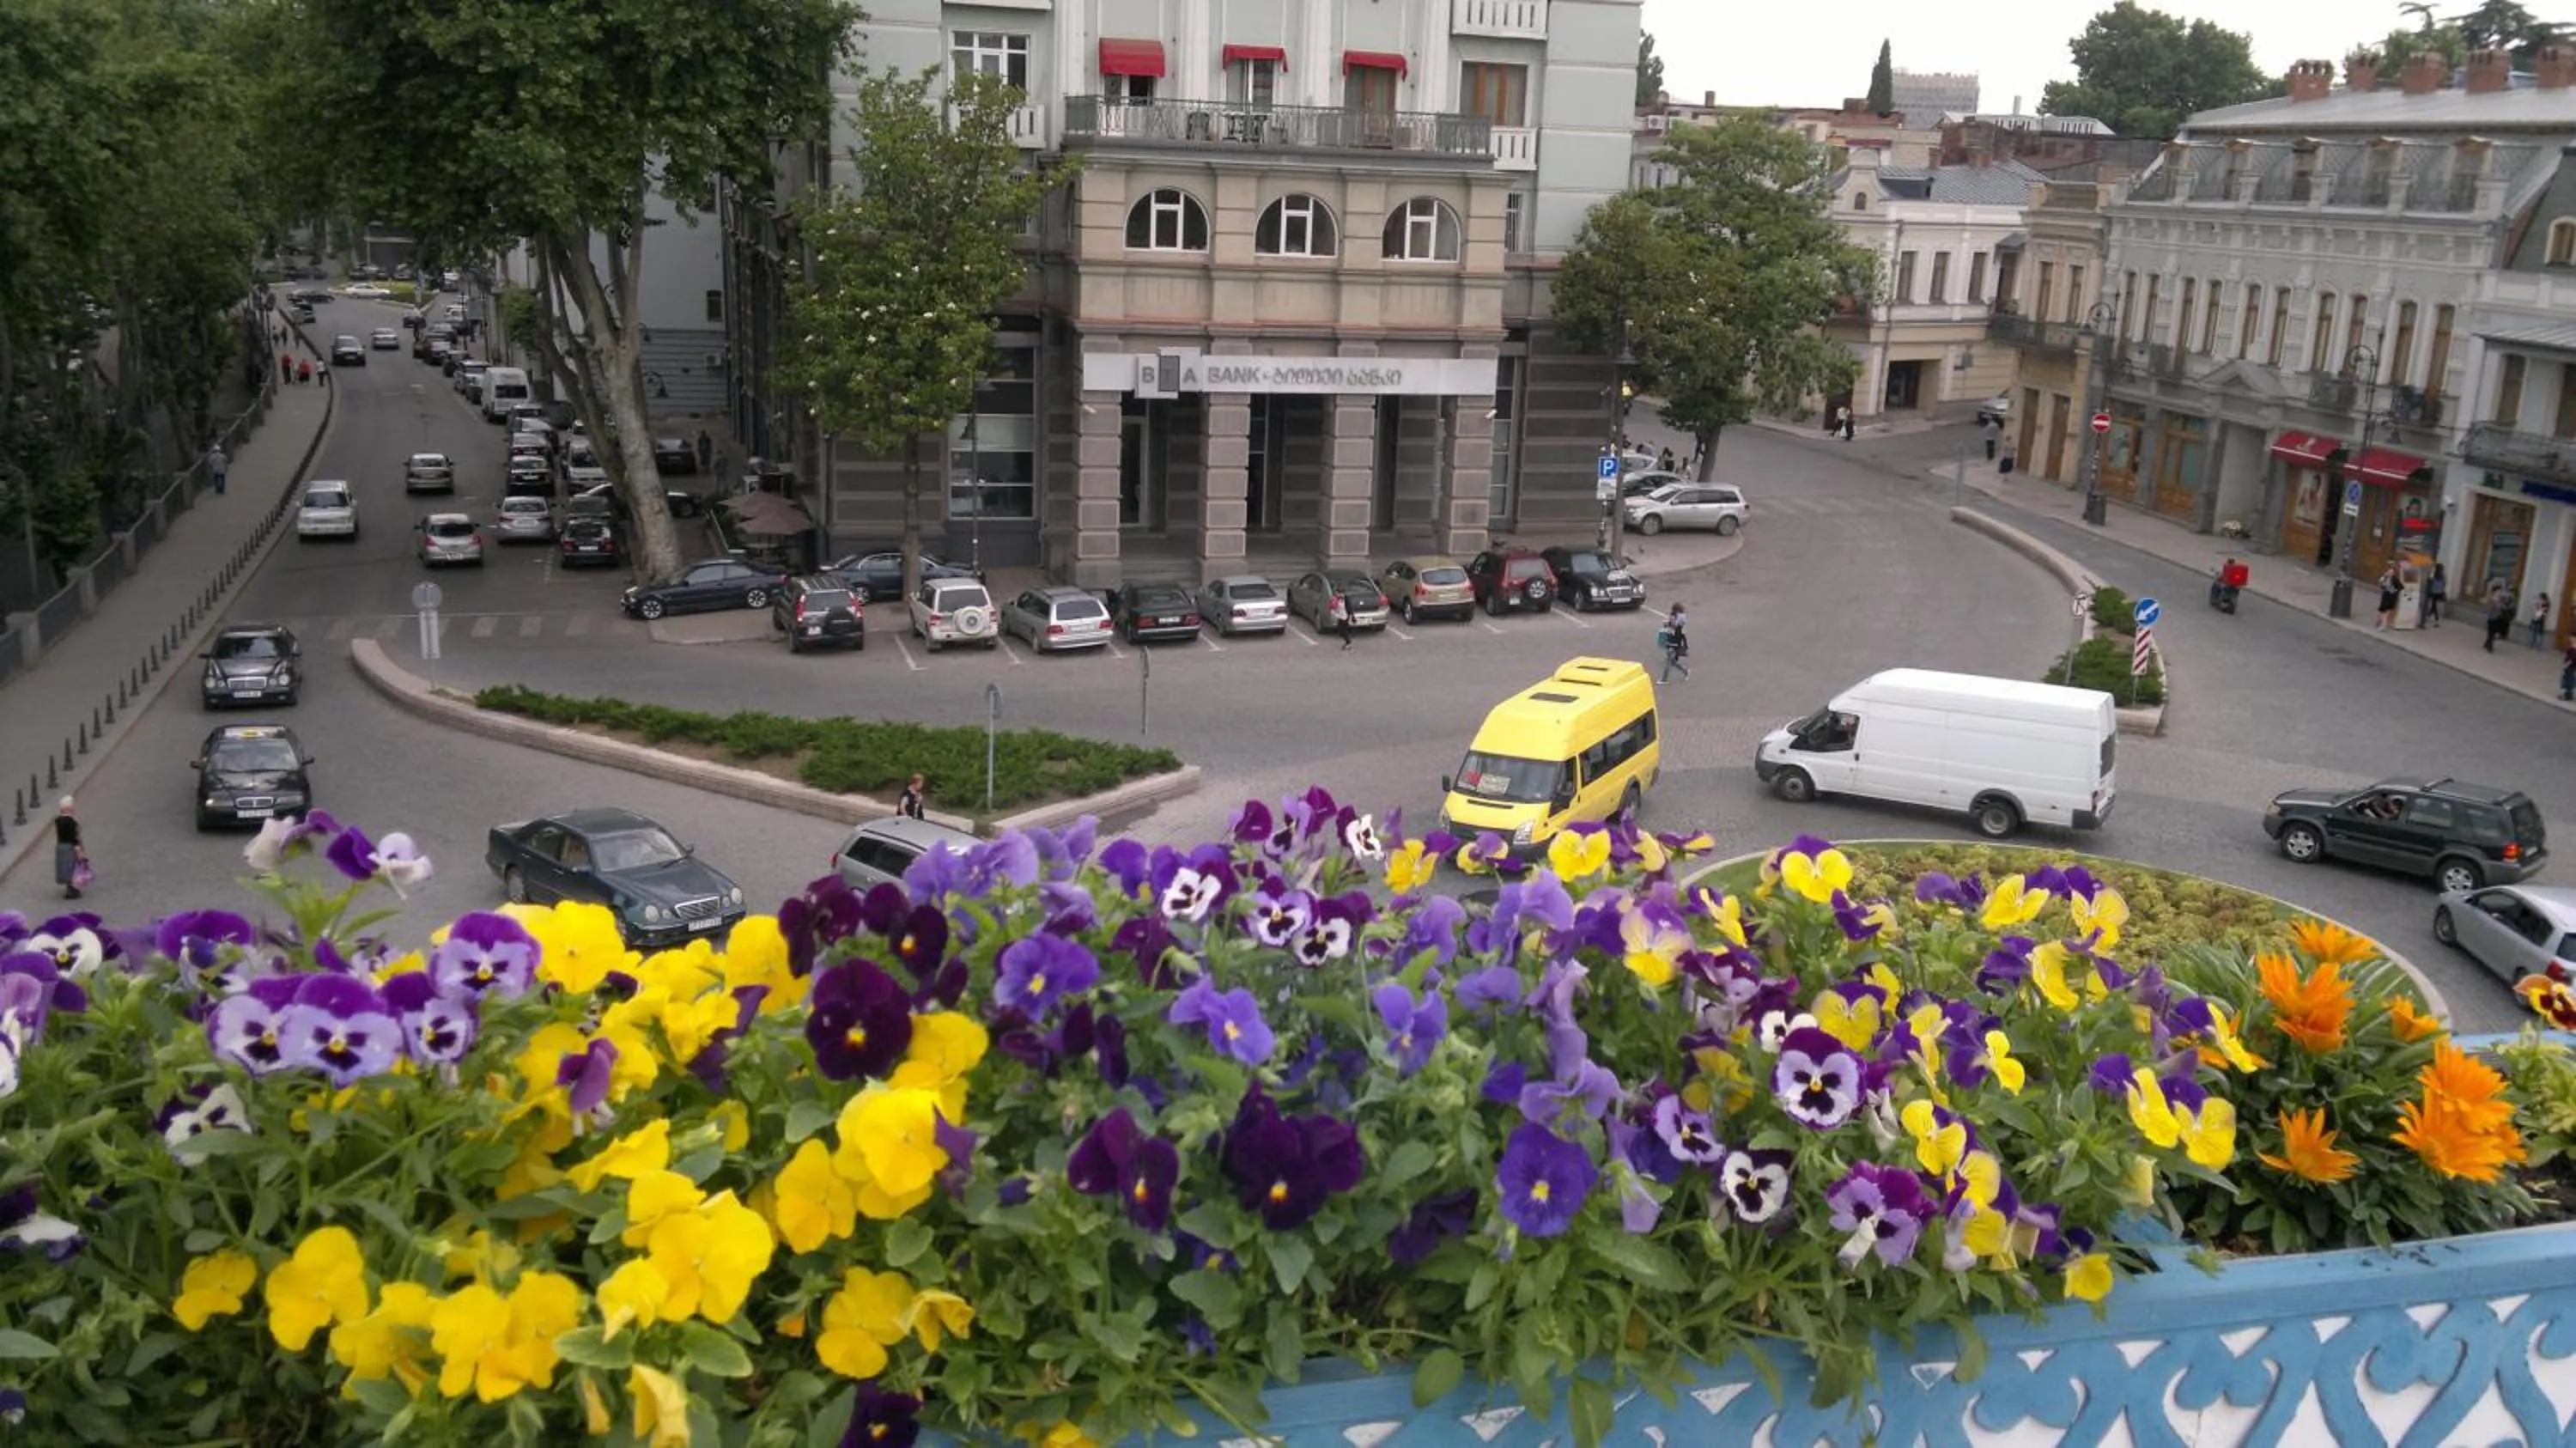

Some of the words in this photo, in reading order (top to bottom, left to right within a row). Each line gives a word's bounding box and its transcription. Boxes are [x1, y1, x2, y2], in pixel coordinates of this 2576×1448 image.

[1142, 366, 1197, 383] BTA
[1207, 366, 1261, 384] BANK
[1603, 459, 1613, 475] P
